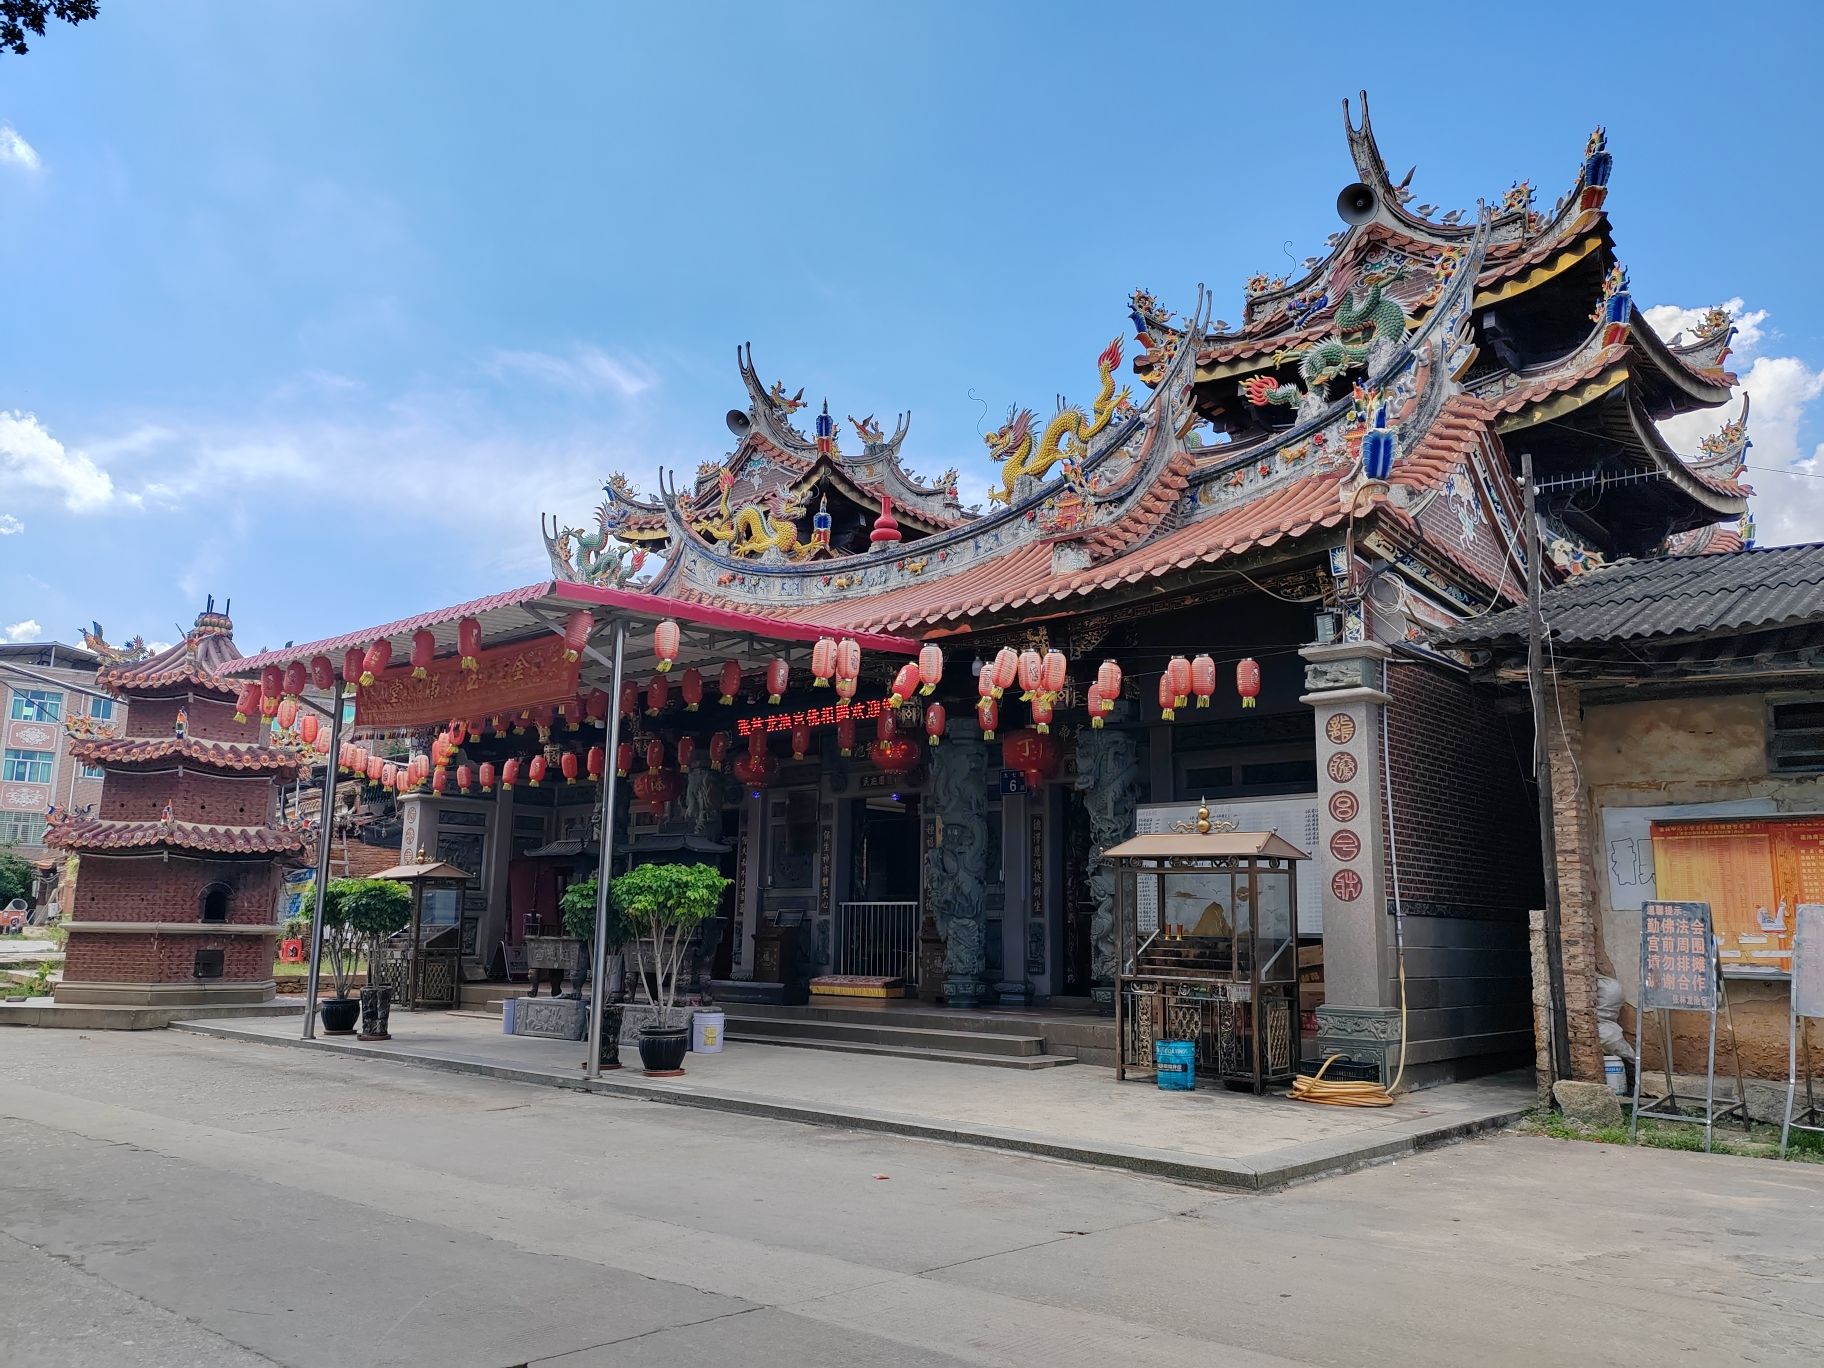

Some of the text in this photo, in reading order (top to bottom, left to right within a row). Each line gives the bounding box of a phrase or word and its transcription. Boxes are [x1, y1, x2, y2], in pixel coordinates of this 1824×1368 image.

[1009, 780, 1017, 792] 6
[1647, 937, 1705, 954] 宫前周围
[1647, 954, 1705, 973] 请勿排摊
